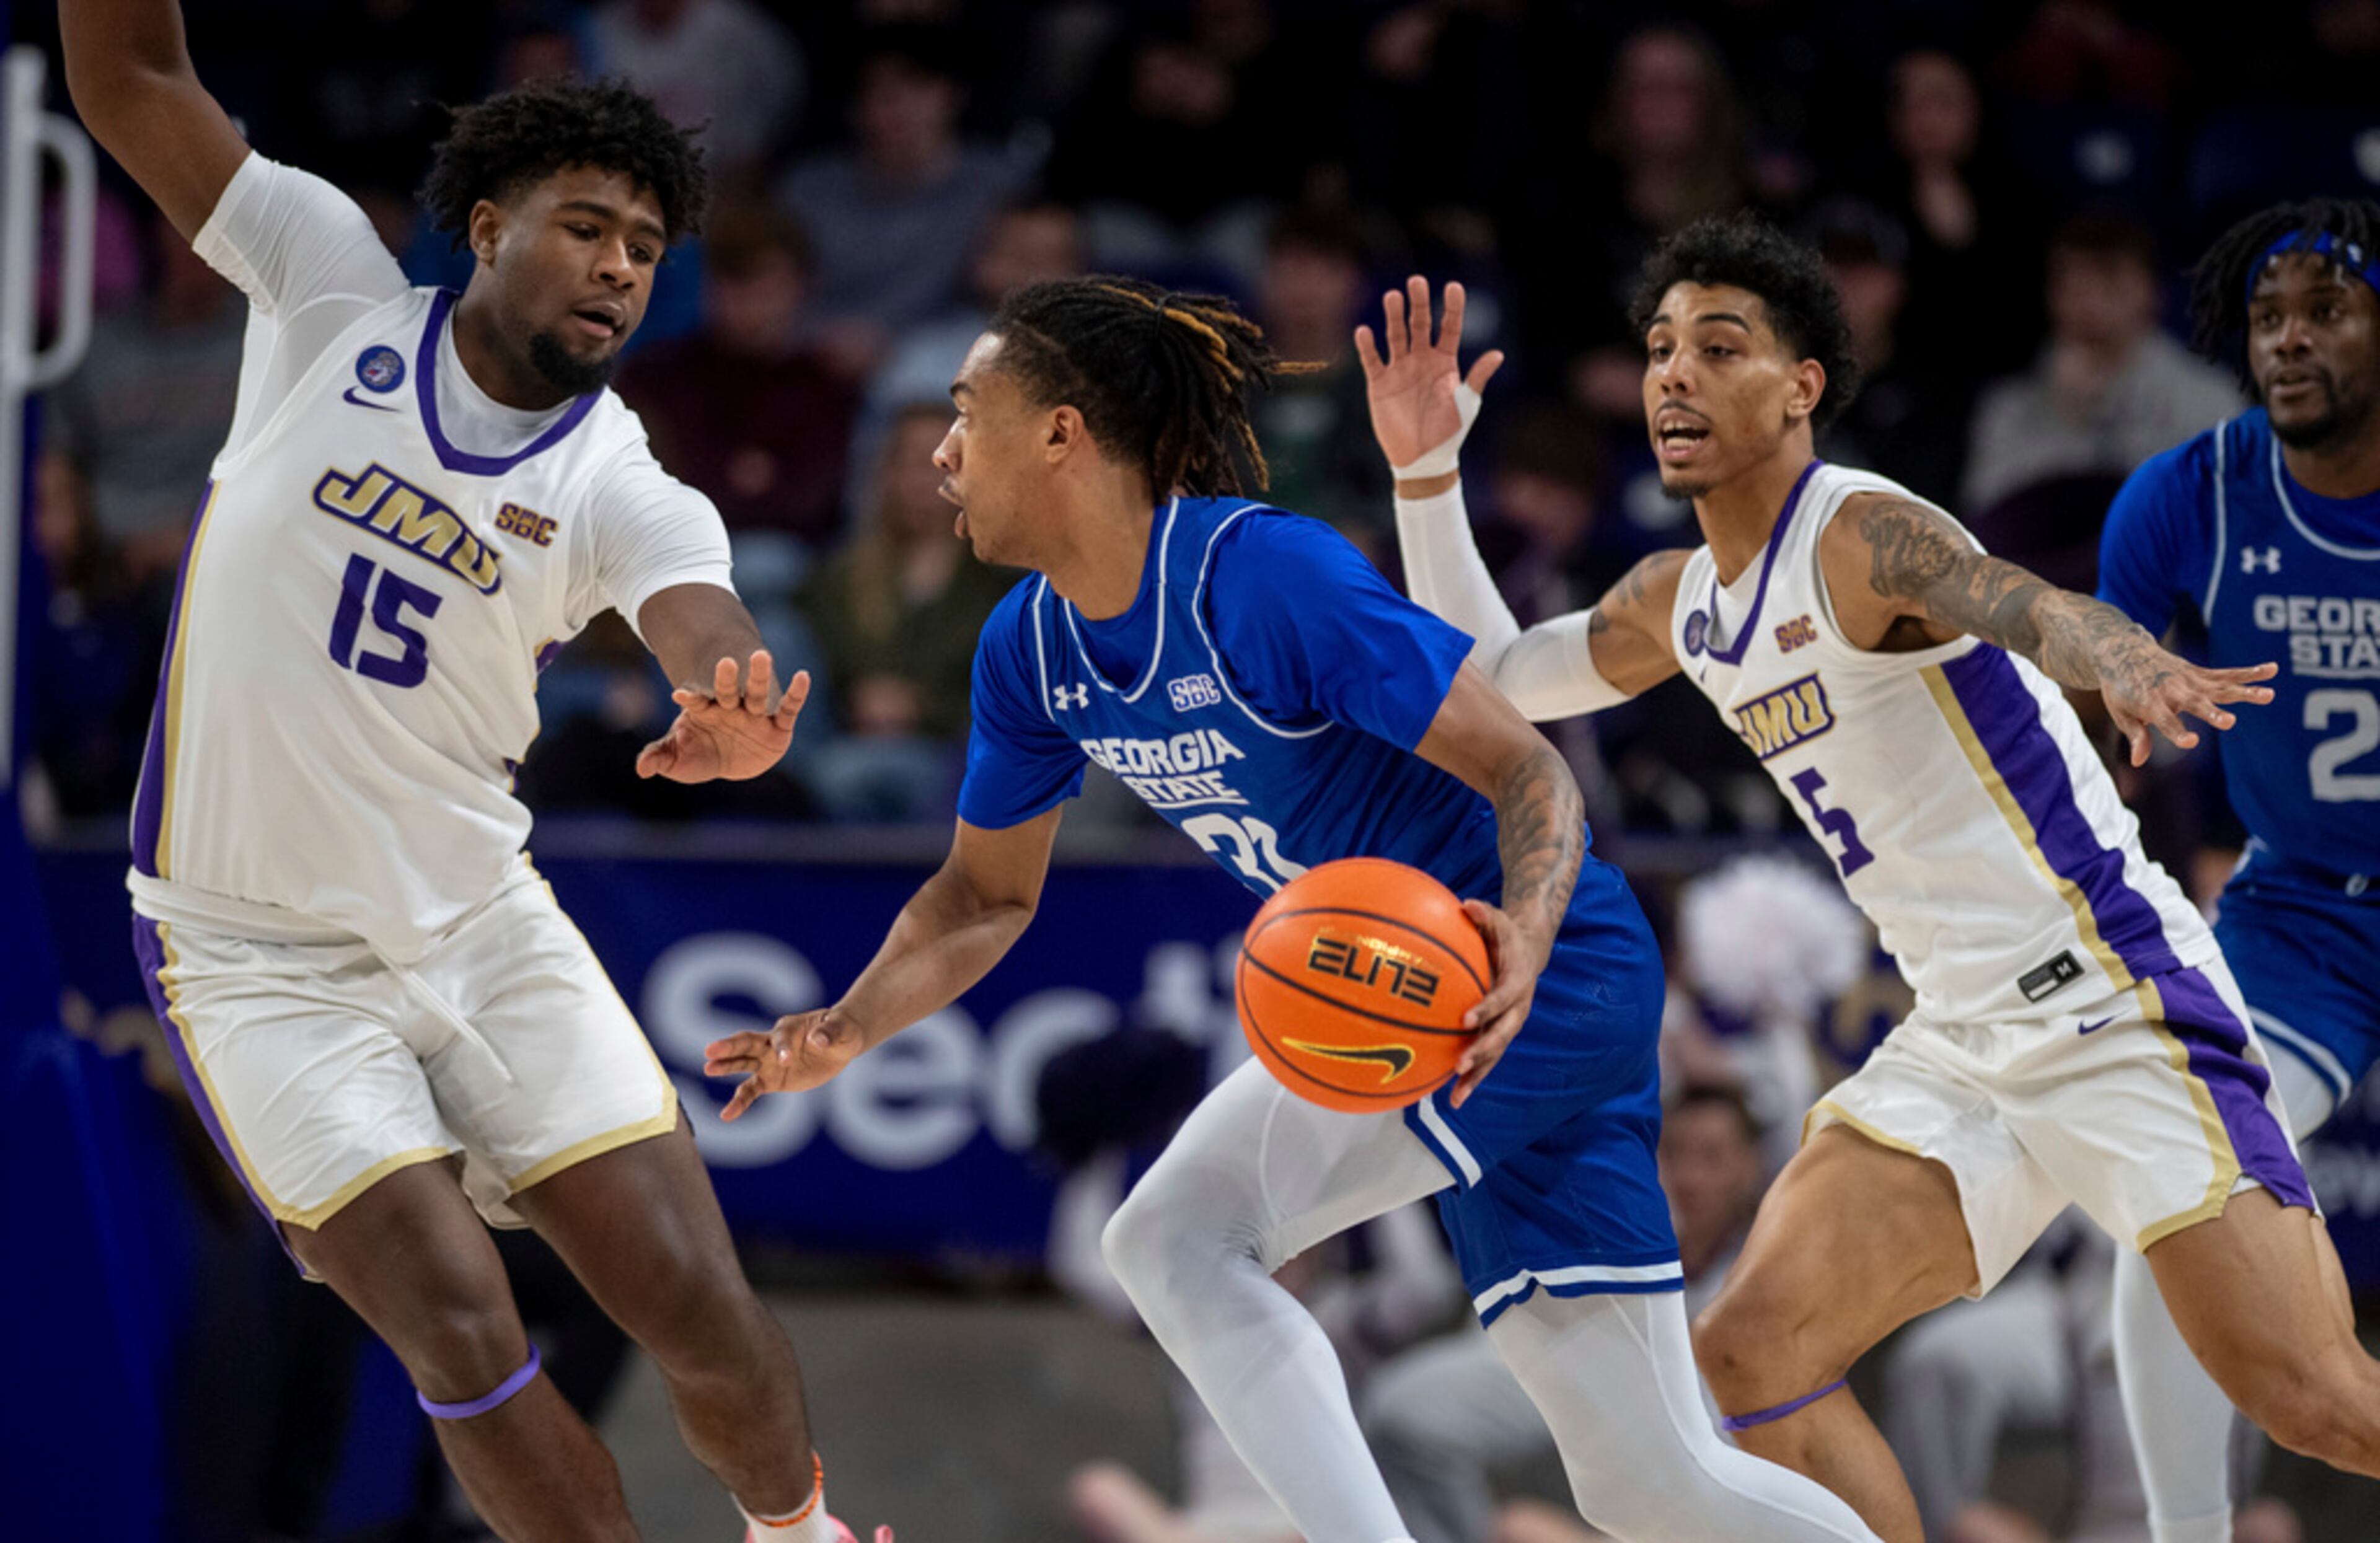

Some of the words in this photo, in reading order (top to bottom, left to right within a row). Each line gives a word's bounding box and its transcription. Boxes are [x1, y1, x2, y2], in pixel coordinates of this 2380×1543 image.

[313, 463, 503, 595] JMU
[496, 503, 558, 547] SBC
[329, 553, 443, 687] 15
[1774, 613, 1818, 654] SBC
[2254, 595, 2380, 633] GEOR
[2288, 635, 2380, 668] STA
[1167, 674, 1221, 711] SBC
[1080, 729, 1246, 775] GEORGIA
[1122, 770, 1240, 801] STATE
[1789, 767, 1875, 877] 5
[1307, 934, 1440, 1008] ELITE
